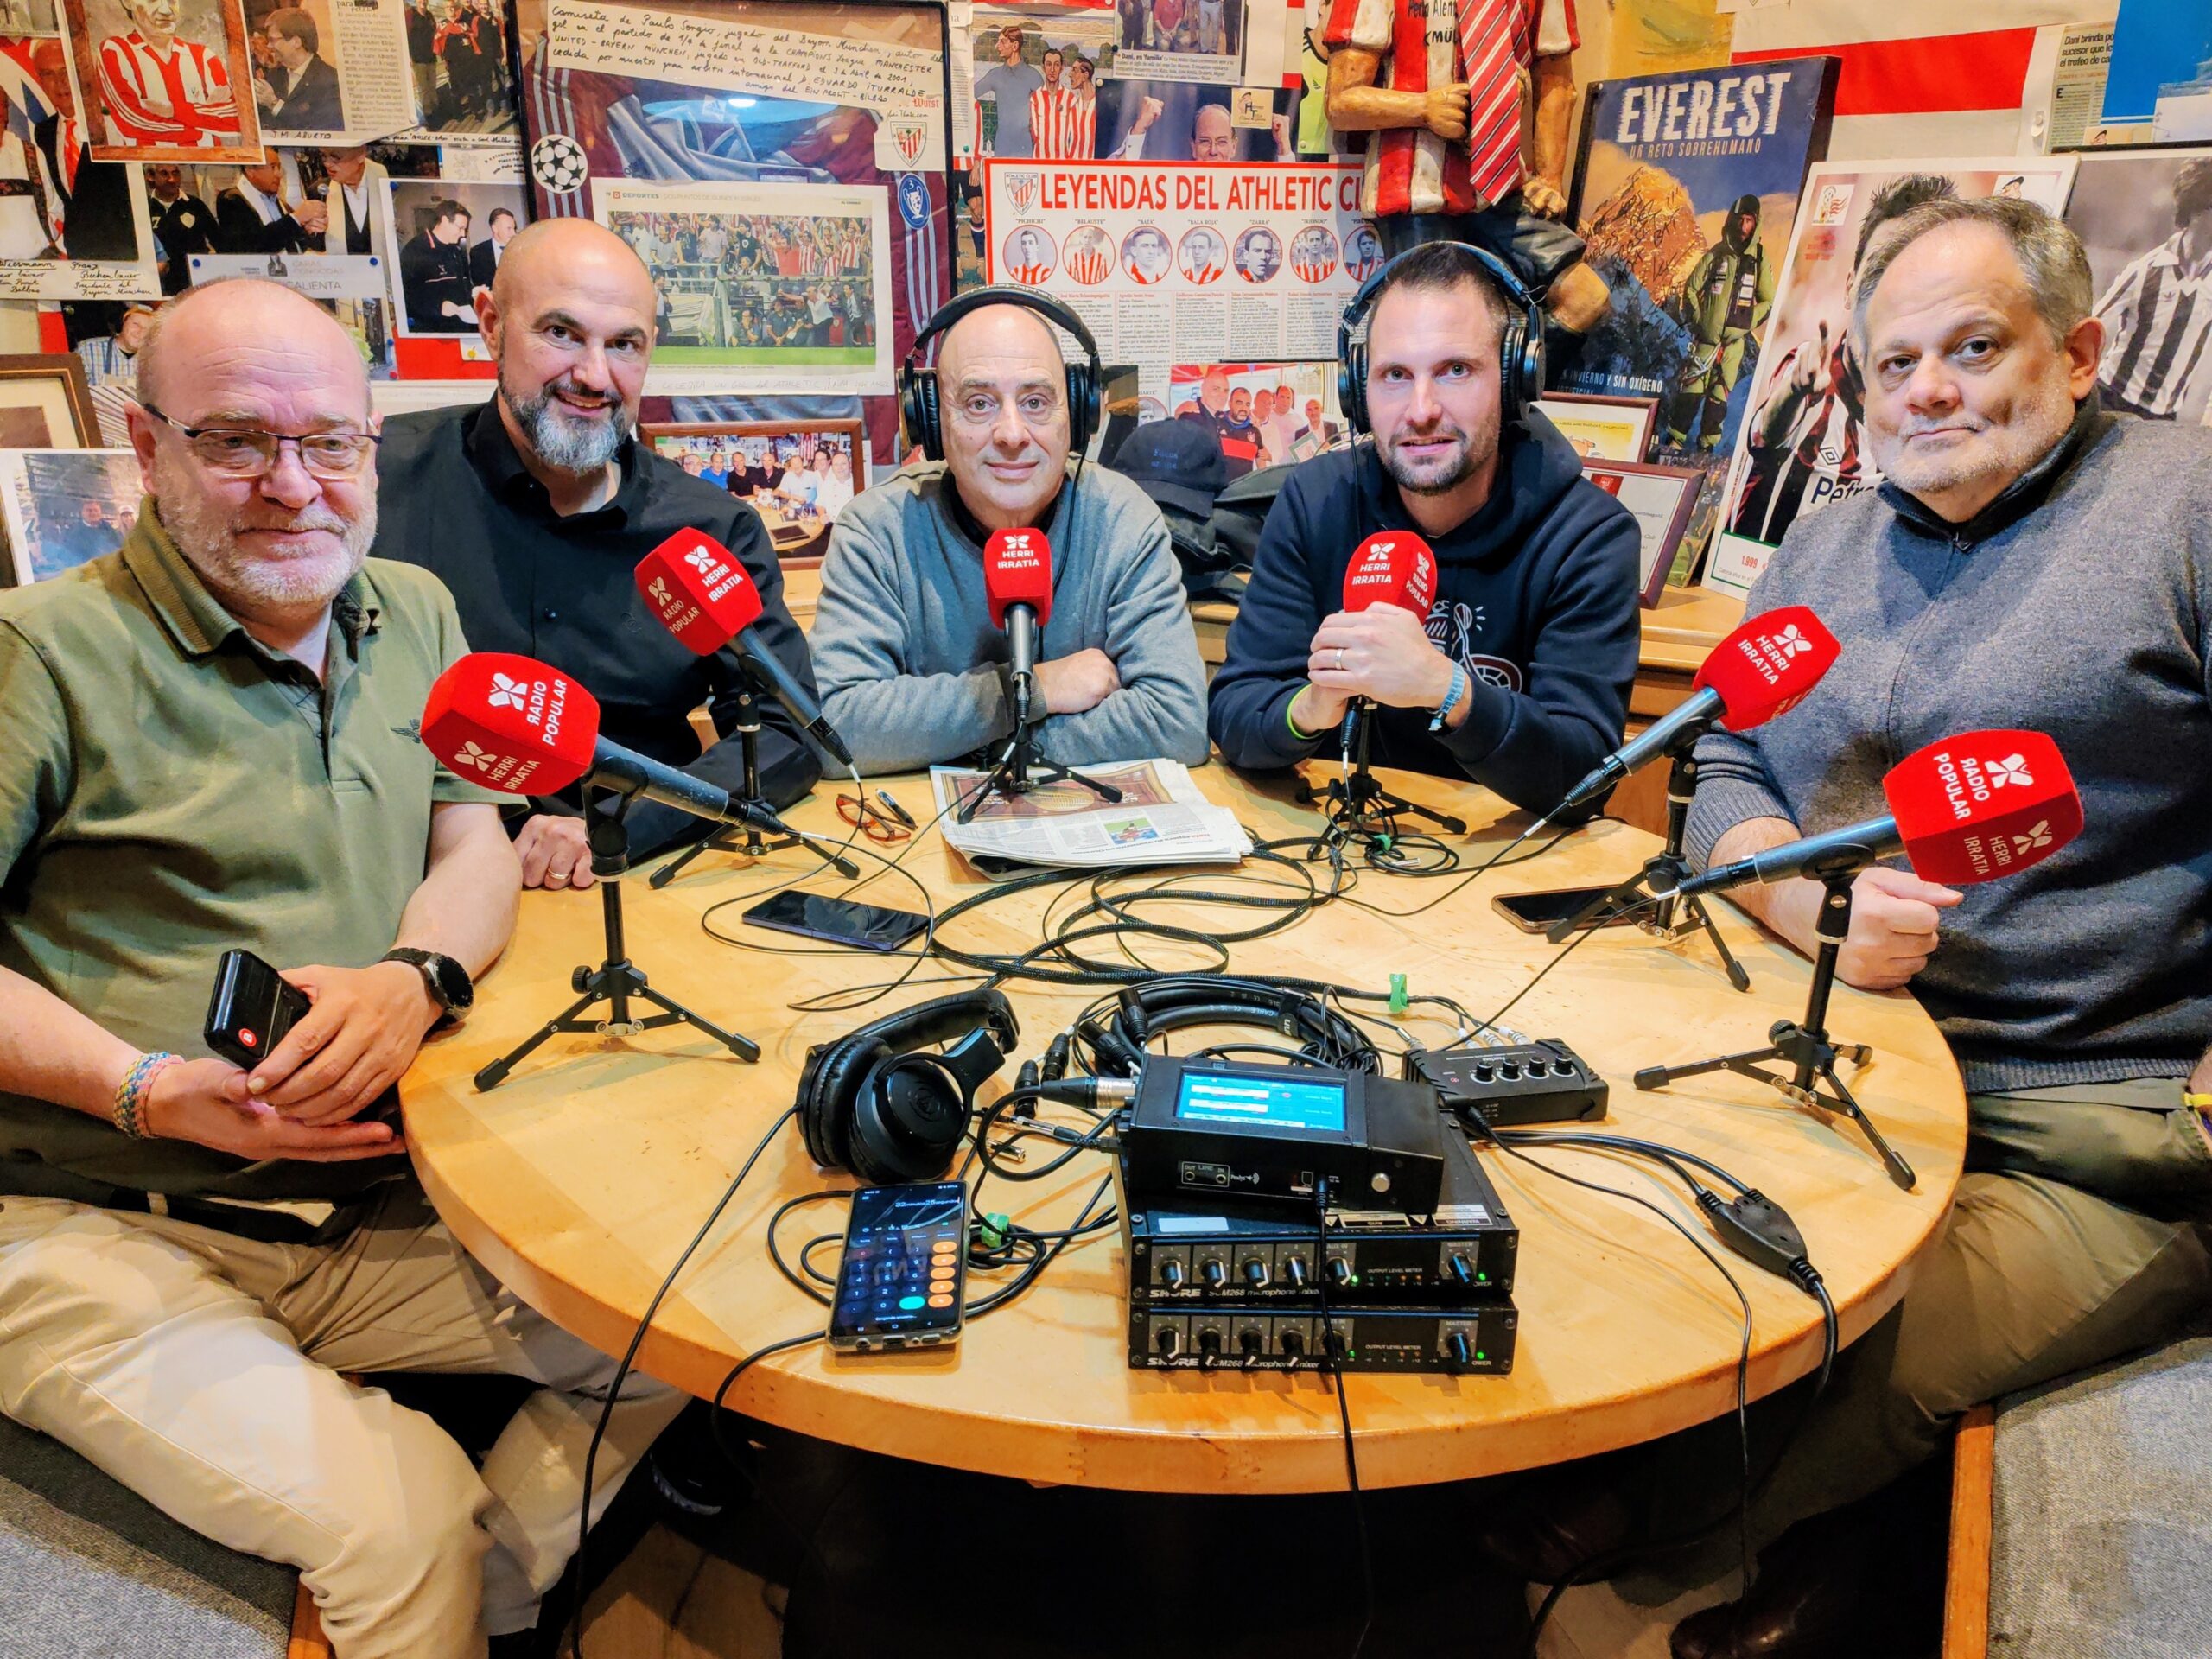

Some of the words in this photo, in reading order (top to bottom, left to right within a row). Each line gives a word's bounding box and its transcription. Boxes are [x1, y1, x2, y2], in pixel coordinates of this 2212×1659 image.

[552, 6, 609, 22] Camiseta
[620, 14, 632, 24] de
[642, 15, 674, 30] Paulo
[724, 26, 766, 41] jugador
[773, 31, 790, 42] del
[895, 49, 924, 59] autor
[930, 53, 944, 63] del
[552, 20, 567, 32] gol
[596, 23, 605, 33] el
[613, 28, 653, 40] partido
[660, 33, 671, 42] de
[712, 41, 742, 53] final
[752, 44, 761, 53] de
[768, 45, 779, 55] la
[875, 59, 933, 74] MANCHESTER
[2064, 35, 2081, 44] Dani
[2081, 34, 2103, 43] brinda
[2105, 34, 2114, 43] po
[601, 40, 635, 51] BAYERN
[695, 49, 728, 63] jugado
[753, 56, 811, 72] OLD-TRAFFORD
[874, 71, 882, 79] de
[2060, 58, 2066, 67] el
[2068, 56, 2088, 67] trofeo
[2090, 54, 2100, 64] de
[2101, 54, 2110, 63] ca
[2062, 46, 2088, 56] sucesor
[2089, 45, 2105, 55] que
[553, 48, 590, 60] cedida
[597, 54, 613, 64] por
[618, 55, 656, 67] nuestro
[663, 61, 683, 72] gran
[728, 64, 793, 82] internacional
[814, 76, 858, 90] EDUARDO
[745, 81, 774, 92] amigo
[782, 84, 798, 94] del
[1617, 72, 1791, 143] EVEREST
[1630, 144, 1643, 159] UN
[1648, 143, 1674, 158] RETO
[1679, 138, 1761, 157] SOBREHUMANO
[1041, 174, 1167, 210] LEYENDAS
[1176, 175, 1219, 210] DEL
[1226, 175, 1332, 211] ATHLETIC
[1339, 175, 1361, 211] CL
[1570, 370, 1605, 385] INVIERNO
[1606, 374, 1611, 385] Y
[1613, 375, 1626, 388] SIN
[1629, 375, 1663, 393] OXÍGENO
[1811, 476, 1875, 504] Petr
[997, 559, 1040, 569] IRRATIA
[1002, 550, 1034, 558] HERRI
[1359, 563, 1390, 572] HERRI
[702, 563, 730, 588] HERRI
[708, 573, 744, 602] IRRATIA
[1352, 574, 1392, 585] IRRATIA
[1406, 580, 1429, 609] POPULAR
[663, 599, 685, 620] RADIO
[669, 607, 701, 634] POPULAR
[1738, 639, 1780, 685] IRRATIA
[1755, 634, 1790, 671] HERRI
[526, 681, 547, 726] RADIO
[542, 678, 568, 747] POPULAR
[486, 755, 518, 782] HERRI
[503, 760, 541, 790] IRRATIA
[1960, 757, 1991, 802] RADIO
[1934, 753, 1972, 820] POPULAR
[1964, 836, 1991, 876] IRRATIA
[1989, 835, 2012, 867] HERRI
